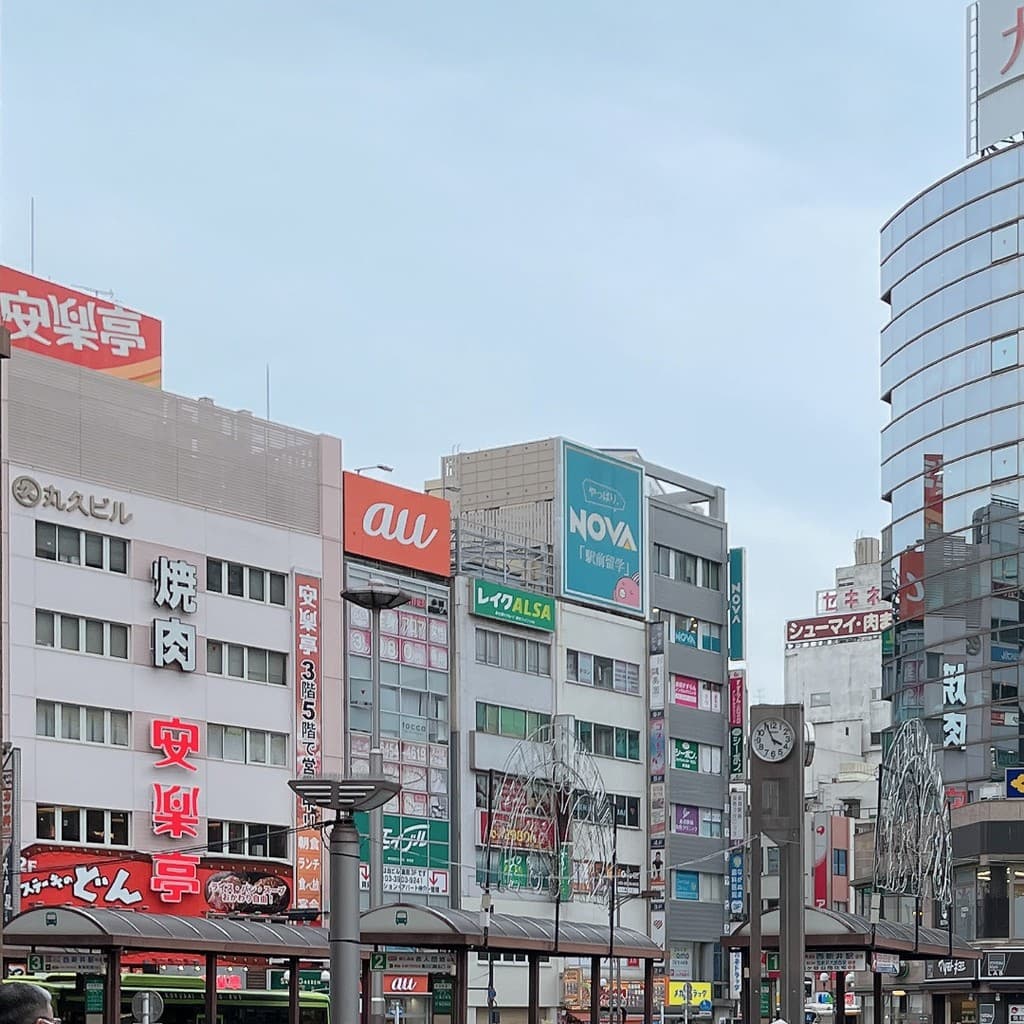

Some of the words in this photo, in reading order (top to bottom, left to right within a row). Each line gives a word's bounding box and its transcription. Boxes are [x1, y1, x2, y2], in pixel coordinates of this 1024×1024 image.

[42, 485, 133, 526] 丸久ビル
[362, 502, 438, 549] au
[569, 505, 638, 552] NOVA
[152, 555, 198, 673] 焼肉
[731, 583, 741, 624] NOVA
[675, 631, 696, 646] NOVA
[150, 716, 201, 904] 安楽亭
[297, 857, 320, 870] ランチ
[32, 955, 42, 970] 3
[374, 954, 384, 969] 2
[391, 977, 417, 991] au
